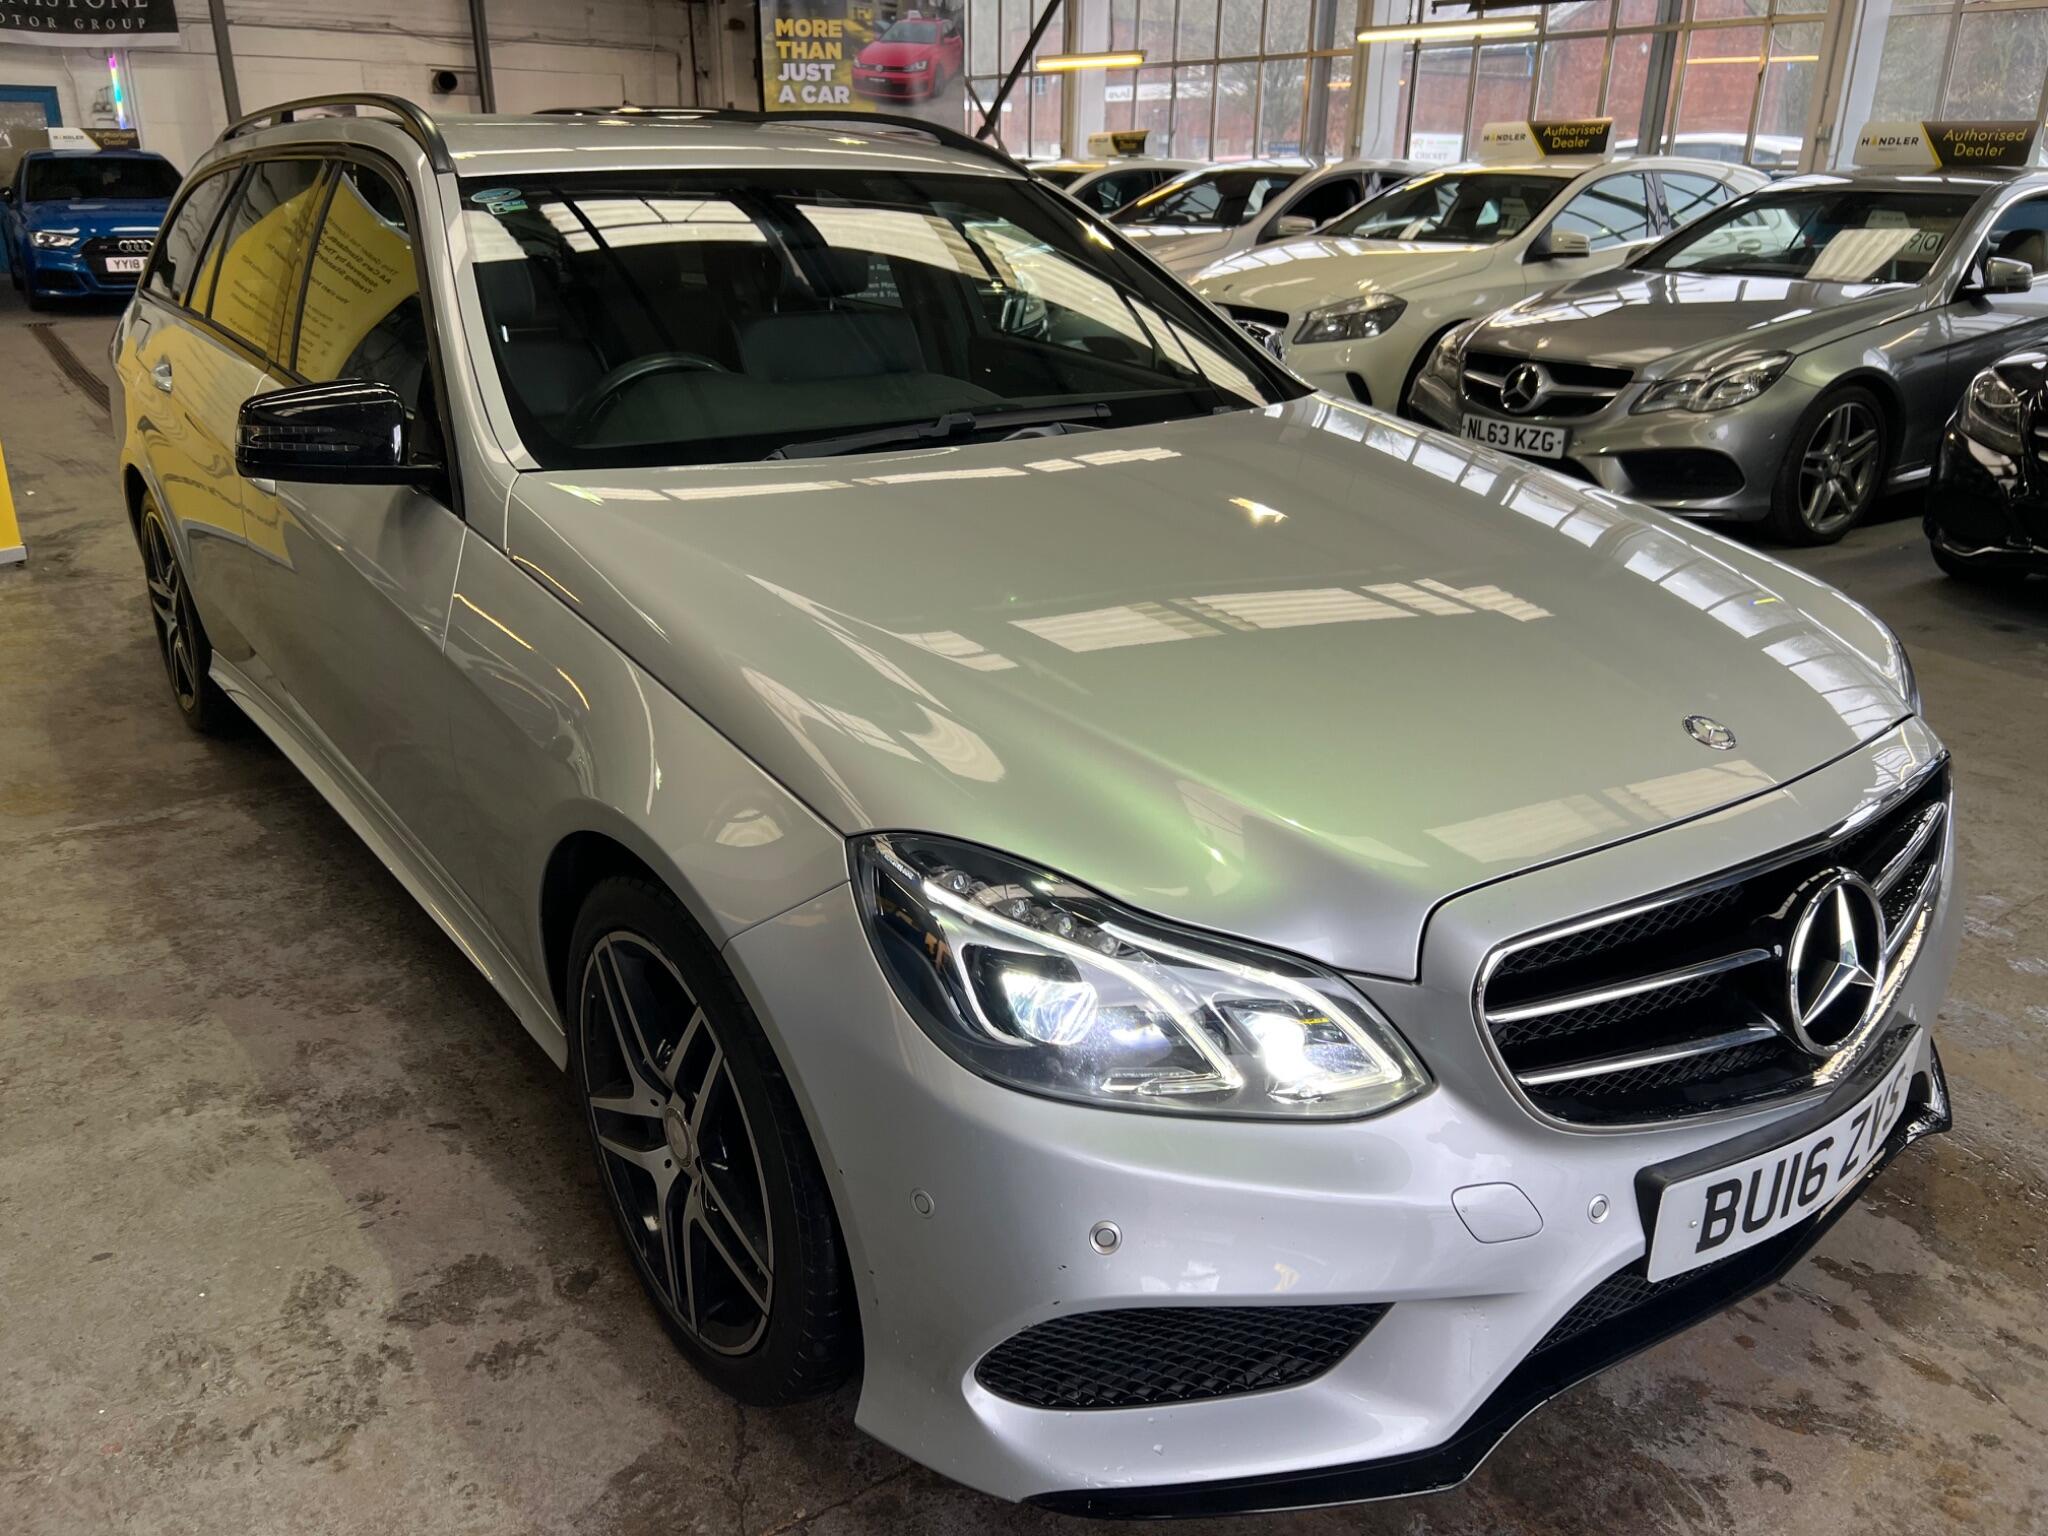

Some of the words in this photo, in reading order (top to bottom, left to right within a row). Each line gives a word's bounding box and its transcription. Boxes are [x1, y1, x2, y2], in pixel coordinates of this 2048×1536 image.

[74, 17, 147, 30] GROUP
[775, 18, 843, 38] MORE
[775, 41, 843, 60] THAN
[778, 63, 836, 82] JUST
[778, 85, 797, 104] A
[801, 84, 850, 104] CAR
[1543, 124, 1604, 137] Authorised
[1943, 128, 2028, 142] Authorised
[1551, 137, 1590, 149] Dealer
[1953, 143, 2006, 157] Dealer
[1467, 418, 1510, 446] NL63
[1514, 427, 1555, 452] KZG
[1695, 1136, 1835, 1254] BU16
[1837, 1063, 1907, 1182] ZVS
